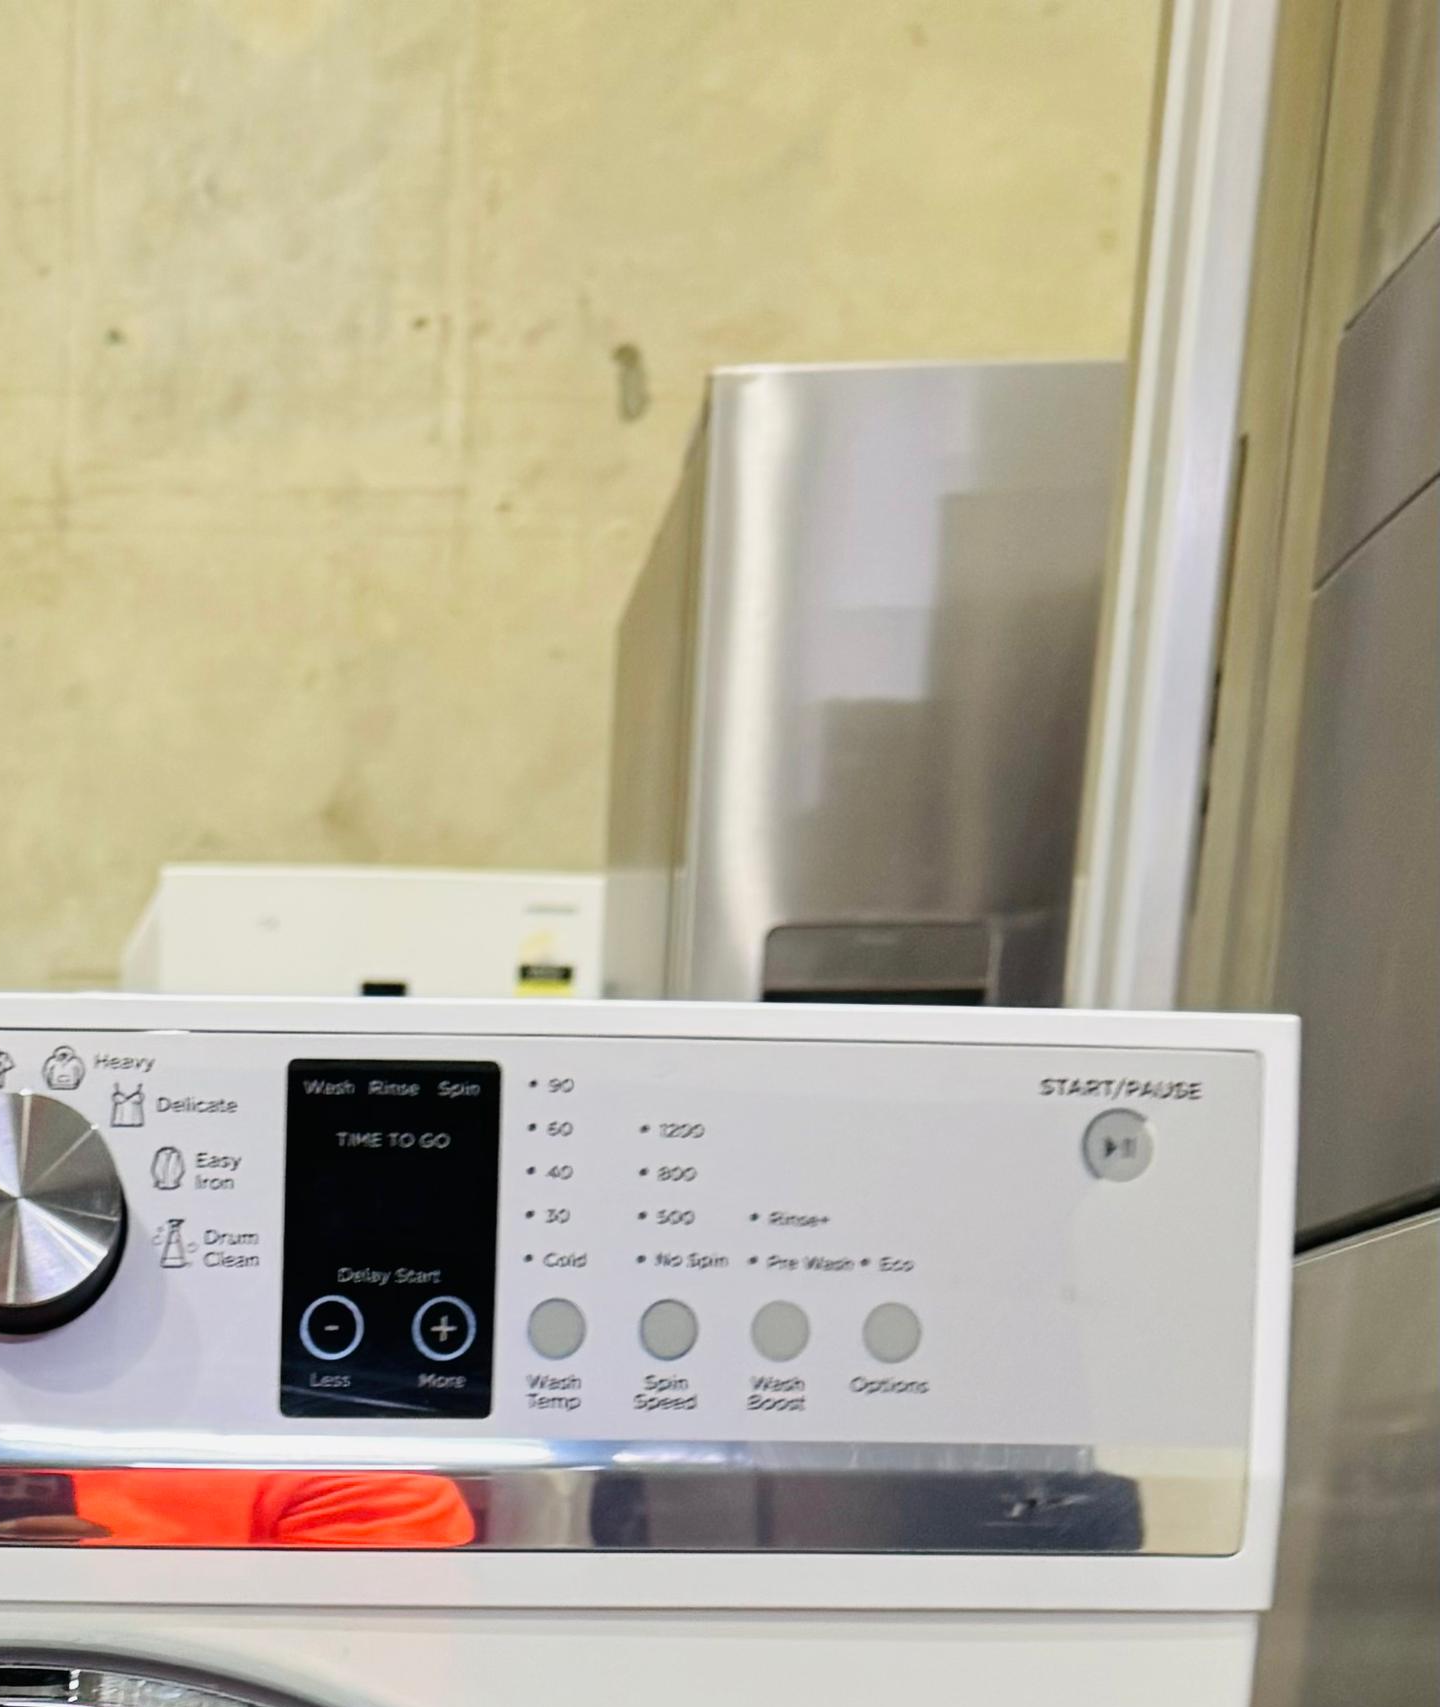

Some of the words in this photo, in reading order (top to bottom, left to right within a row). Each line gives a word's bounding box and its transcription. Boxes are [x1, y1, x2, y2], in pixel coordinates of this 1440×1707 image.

[94, 1054, 156, 1072] Heavy
[303, 1080, 356, 1095] Wash
[368, 1081, 420, 1096] Rinse
[438, 1080, 481, 1097] Spin
[548, 1078, 575, 1093] 90
[1039, 1078, 1203, 1100] START/PAUSE
[156, 1097, 238, 1114] Delicate
[546, 1121, 573, 1137] 60
[336, 1132, 383, 1148] TIME
[389, 1132, 415, 1148] TO
[418, 1133, 451, 1149] GO
[195, 1152, 241, 1171] Easy
[545, 1165, 573, 1180] 40
[657, 1166, 698, 1182] 800
[195, 1175, 235, 1190] Iron
[544, 1209, 571, 1224] 30
[656, 1209, 695, 1225] 500
[203, 1229, 259, 1245] Drum
[203, 1251, 260, 1267] Clean
[543, 1252, 588, 1268] Cold
[654, 1252, 682, 1268] No
[686, 1253, 729, 1269] Spin
[766, 1255, 798, 1270] Pre
[803, 1256, 855, 1271] Wash
[878, 1256, 914, 1272] Eco
[337, 1268, 391, 1285] Delay
[394, 1268, 442, 1283] Start
[310, 1373, 351, 1388] Less
[418, 1374, 467, 1388] More
[526, 1374, 582, 1390] Wash
[644, 1374, 689, 1392] Spin
[750, 1376, 805, 1392] Wash
[849, 1376, 930, 1394] Options
[525, 1393, 582, 1411] Temp
[633, 1393, 698, 1411] Speed
[746, 1394, 805, 1411] Boost
